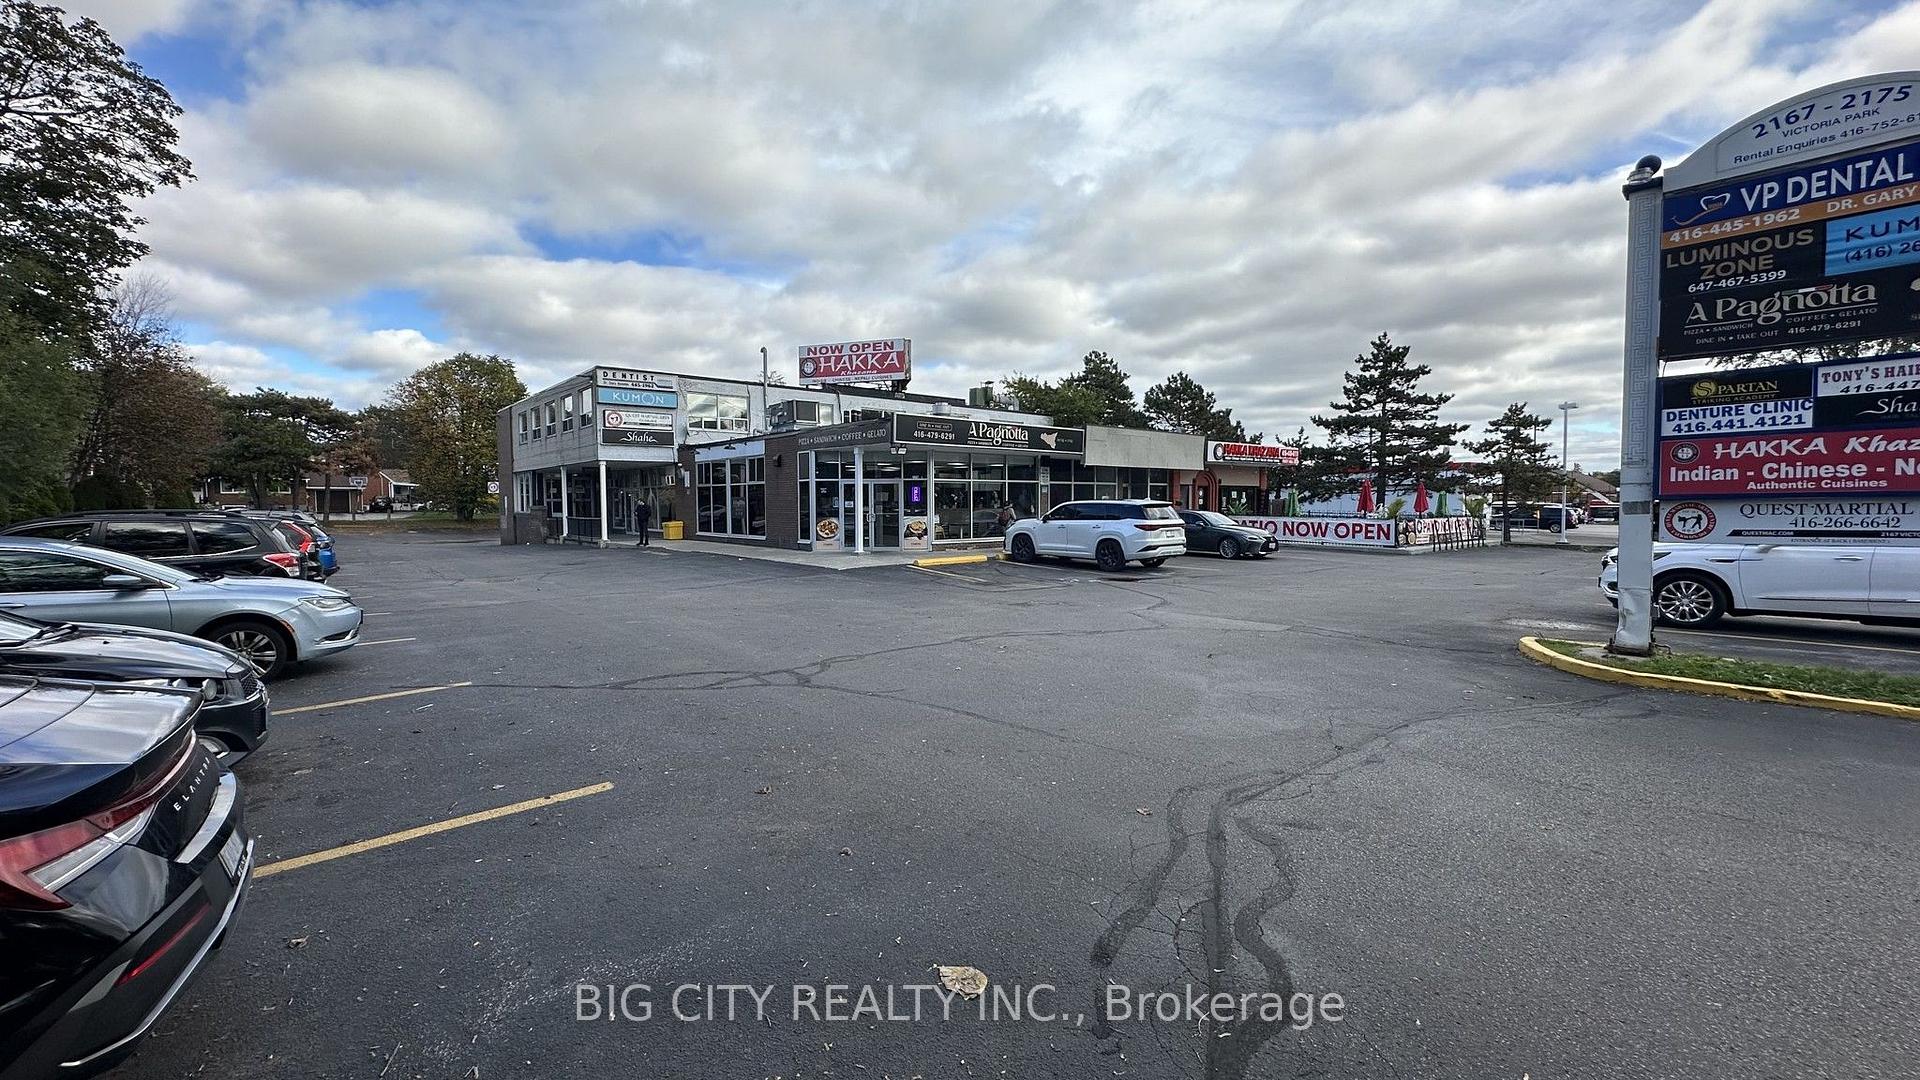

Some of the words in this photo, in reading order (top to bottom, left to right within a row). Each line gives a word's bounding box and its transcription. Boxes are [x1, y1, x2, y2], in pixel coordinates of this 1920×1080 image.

[1752, 103, 1816, 139] 2167
[1840, 85, 1912, 111] 2175
[1782, 117, 1841, 137] VICTORIA
[1844, 107, 1880, 123] PARK
[1734, 147, 1773, 164] Rental
[1776, 134, 1836, 154] Enquiries
[1740, 182, 1780, 212] VP
[1787, 153, 1914, 205] DENTAL
[1669, 208, 1801, 242] 416-445-1962
[1827, 198, 1858, 213] DR.
[1863, 185, 1916, 206] GARY
[1666, 228, 1815, 270] LUMINOUS
[1845, 244, 1893, 264] (416)
[1700, 254, 1774, 280] ZONE
[1688, 269, 1787, 293] 647-467-5399
[1686, 302, 1709, 324] A
[1715, 282, 1878, 326] Pagnotta
[1683, 328, 1705, 336] PIZZA
[1712, 322, 1754, 333] SANDWICH
[1785, 313, 1828, 324] COFFEE
[1838, 307, 1878, 318] GELATO
[1736, 331, 1758, 341] TAKE
[1759, 329, 1780, 338] OUT
[1787, 319, 1862, 335] 416-479-6291
[806, 344, 845, 356] NOW
[849, 341, 894, 353] OPEN
[819, 351, 900, 373] HAKKA
[602, 371, 655, 381] DENTIST
[1821, 366, 1880, 384] TONY'S
[612, 391, 664, 405] KUMON
[1735, 393, 1777, 402] ACADEMY
[1666, 404, 1746, 422] DENTURE
[1750, 398, 1814, 415] CLINIC
[968, 422, 978, 438] A
[978, 422, 1029, 446] Pagnotta
[1671, 413, 1807, 434] 416.441.4121
[1713, 437, 1828, 460] HAKKA
[1669, 465, 1740, 482] Indian
[1761, 461, 1869, 479] Chinese
[1746, 479, 1817, 490] Authentic
[1821, 478, 1889, 489] Cuisines
[1739, 502, 1808, 519] QUEST
[1813, 502, 1914, 516] MARTIAL
[1282, 520, 1330, 538] NOW
[1334, 522, 1391, 541] OPEN
[1789, 516, 1901, 529] 416-266-6642
